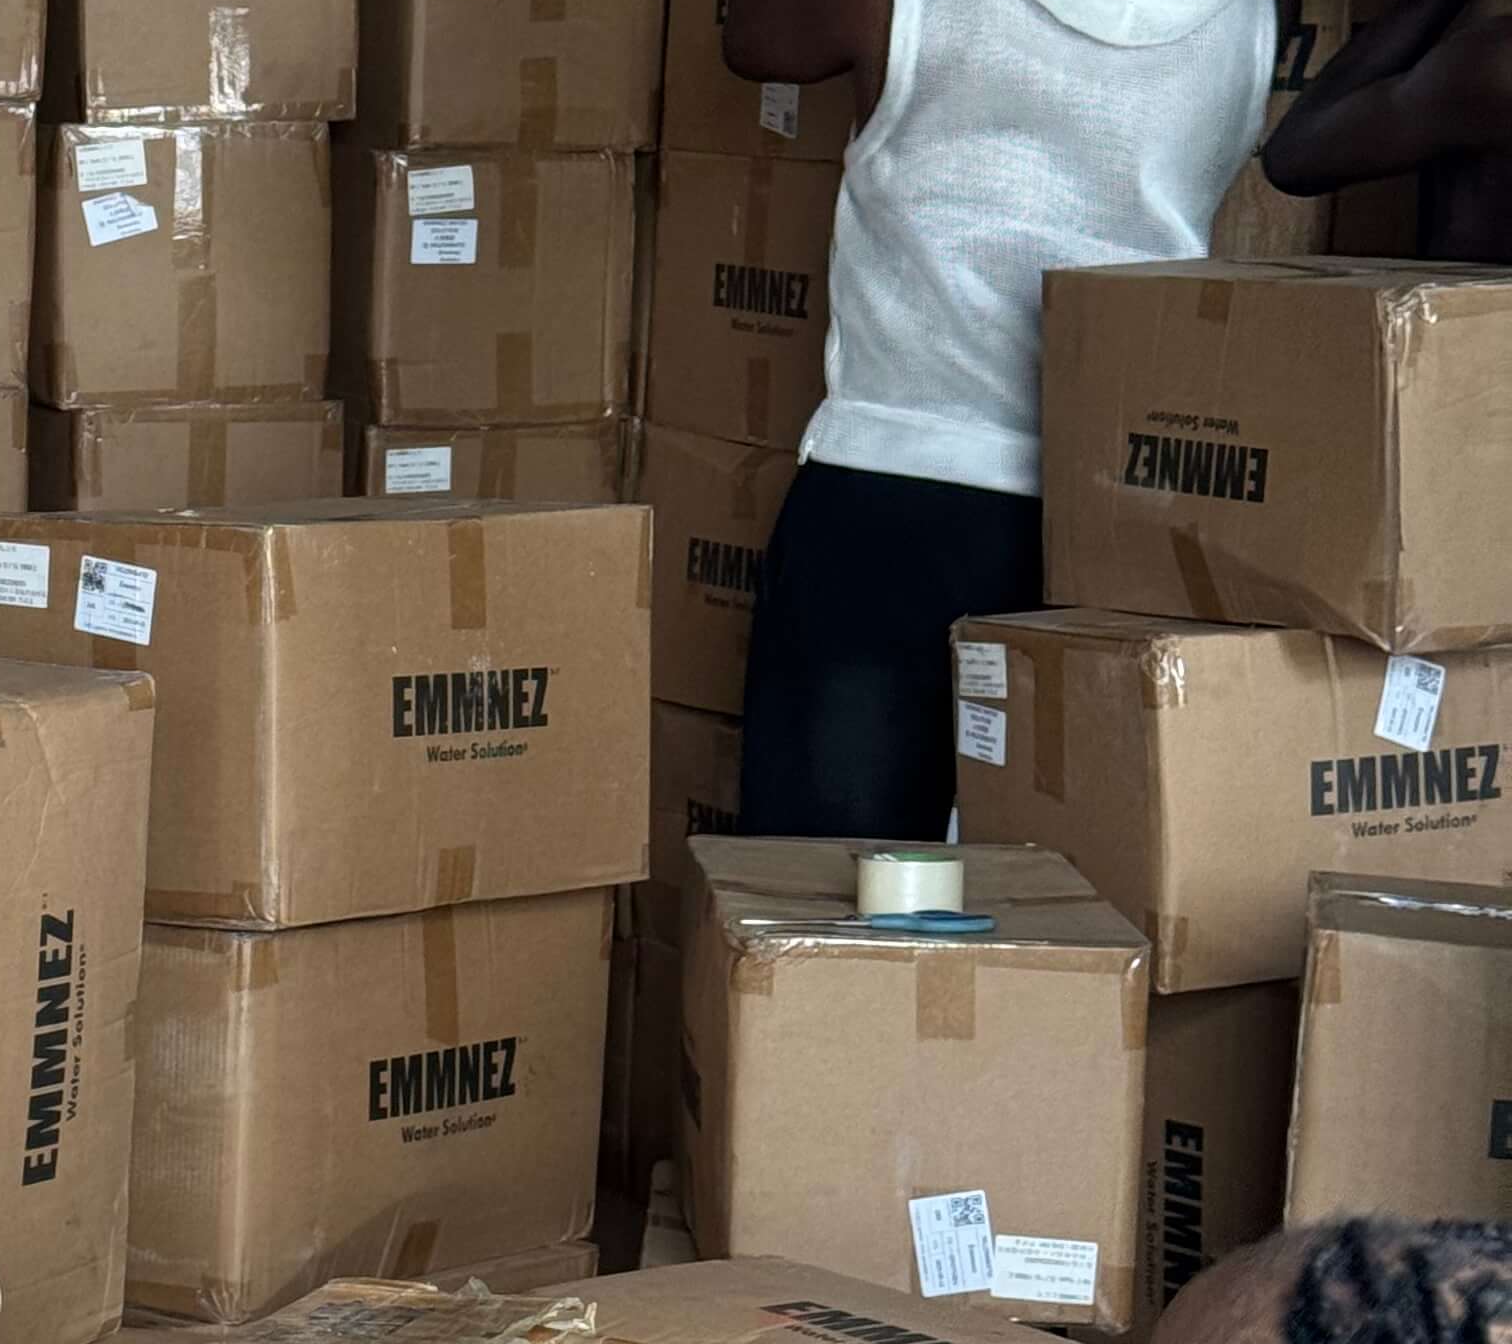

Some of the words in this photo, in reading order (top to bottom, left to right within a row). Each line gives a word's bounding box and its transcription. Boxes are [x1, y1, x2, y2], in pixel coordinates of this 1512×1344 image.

[713, 263, 809, 321] EMMNEZ
[1124, 432, 1269, 504] EMMNEZ
[687, 537, 760, 592] EMMN
[392, 666, 549, 738] EMMNEZ
[426, 744, 468, 763] Water
[1311, 744, 1502, 817] EMMNEZ
[1351, 817, 1401, 840] Water
[21, 909, 75, 1187] EMMNEZ
[368, 1036, 517, 1122] EMMNEZ
[63, 1056, 80, 1122] Water
[401, 1123, 439, 1144] Water
[1162, 1118, 1205, 1311] EMMN
